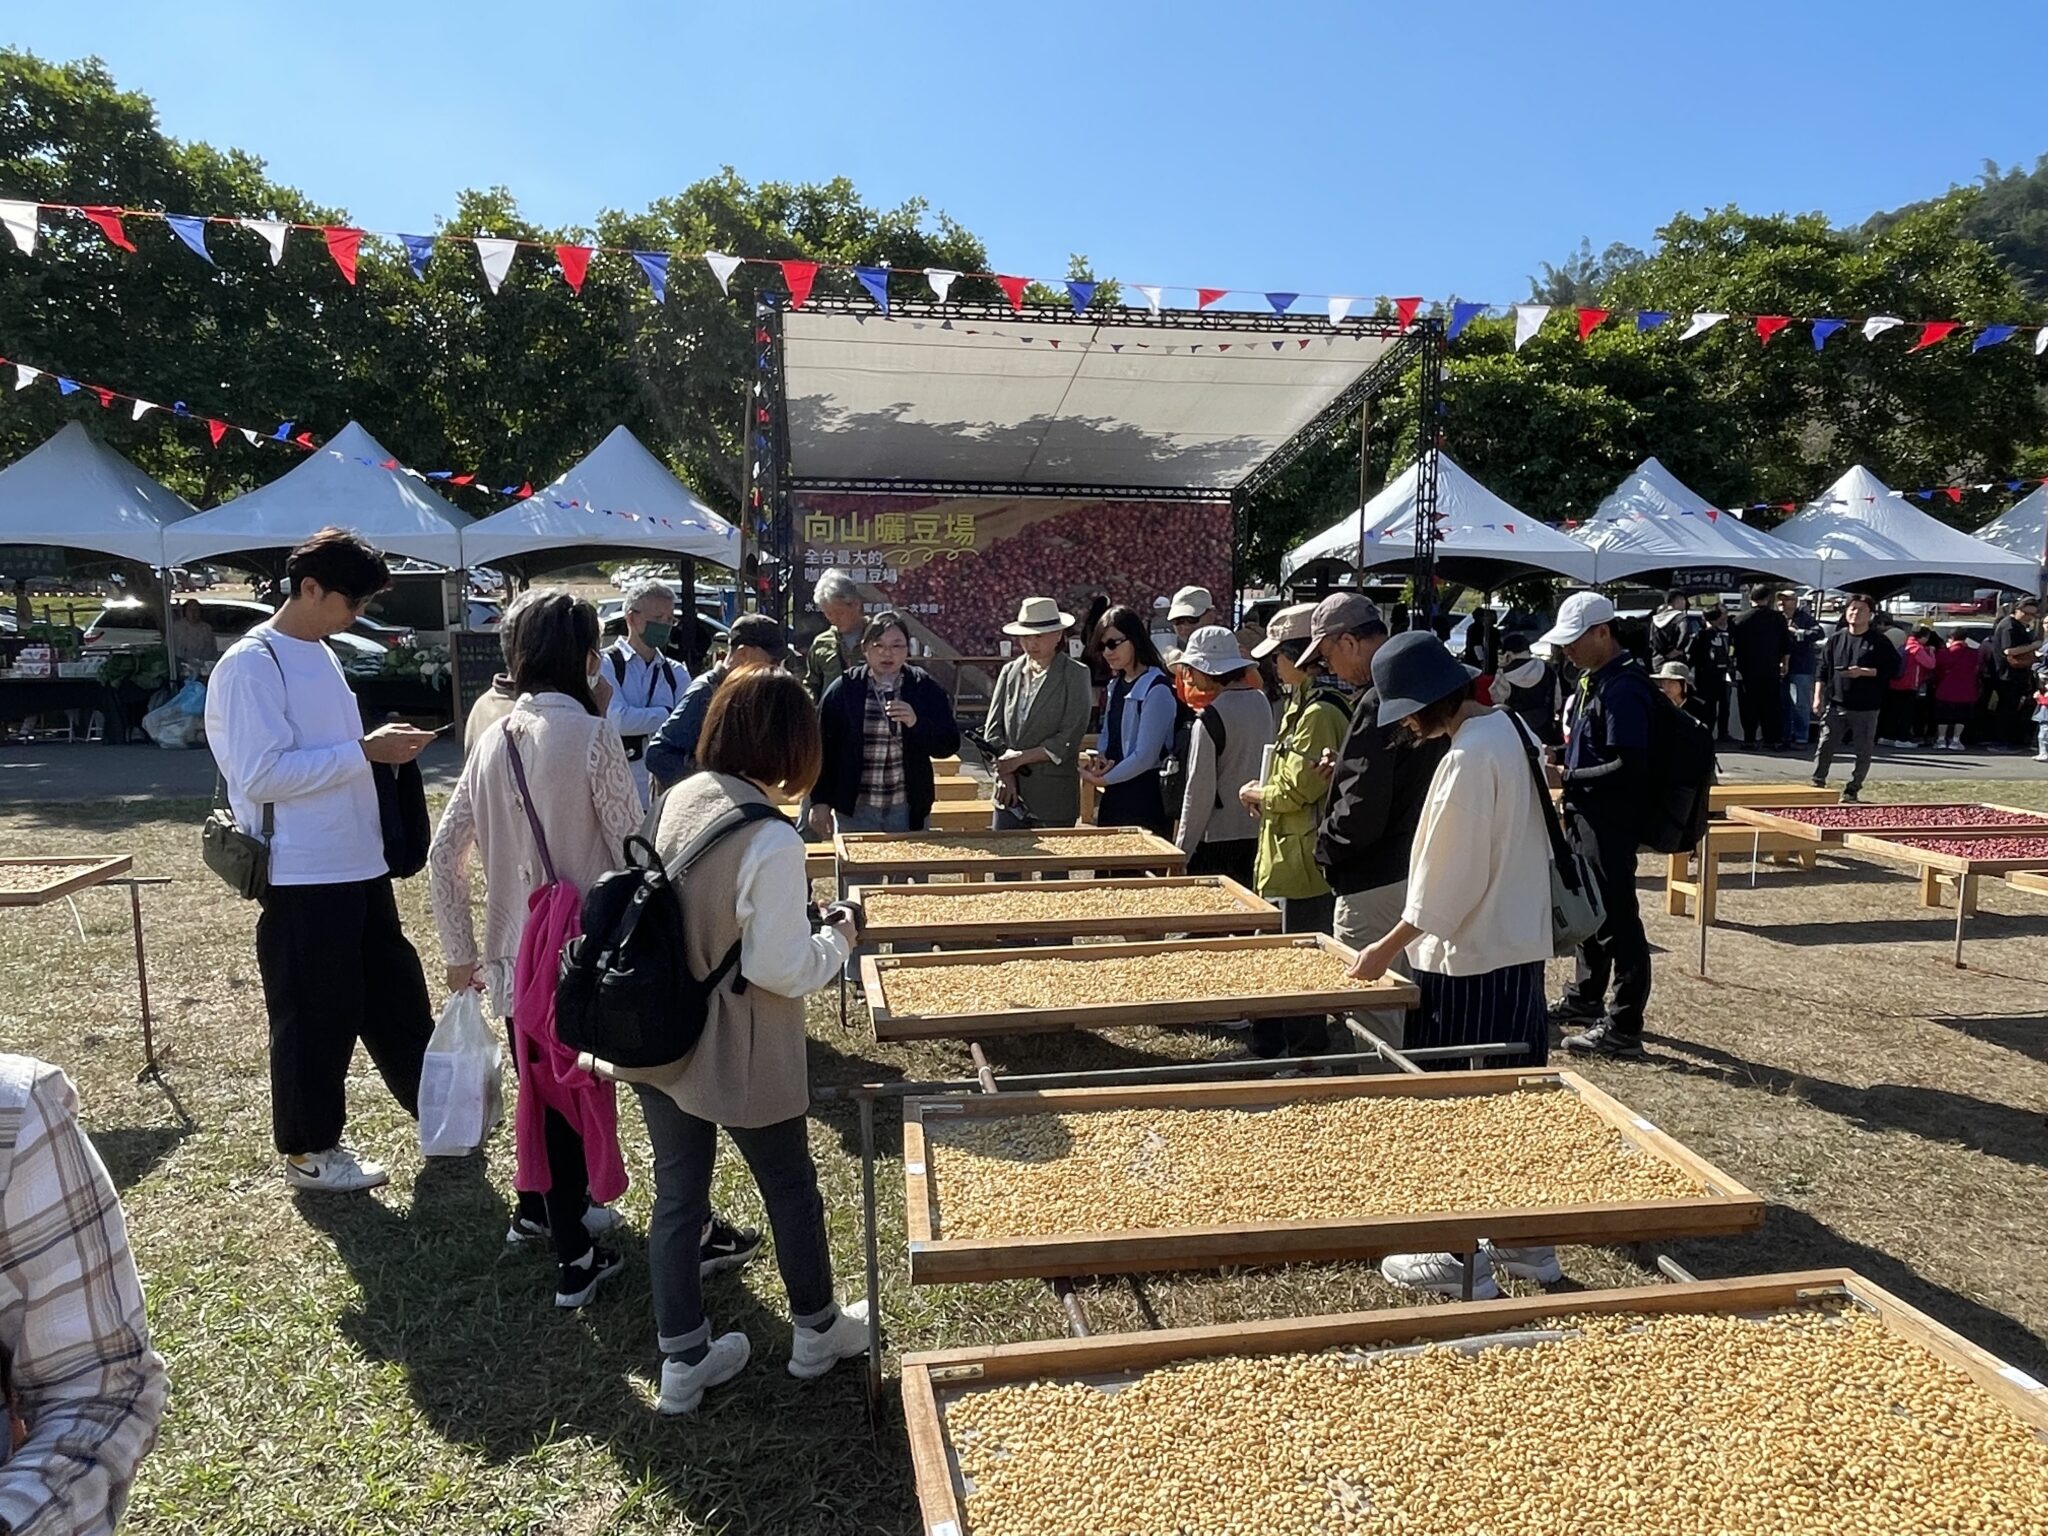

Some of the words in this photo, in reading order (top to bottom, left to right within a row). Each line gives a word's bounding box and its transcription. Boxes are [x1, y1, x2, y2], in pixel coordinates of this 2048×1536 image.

[804, 510, 976, 546] 向山曬豆場
[804, 549, 883, 565] 全台最大的
[804, 567, 898, 584] 咖曬豆場
